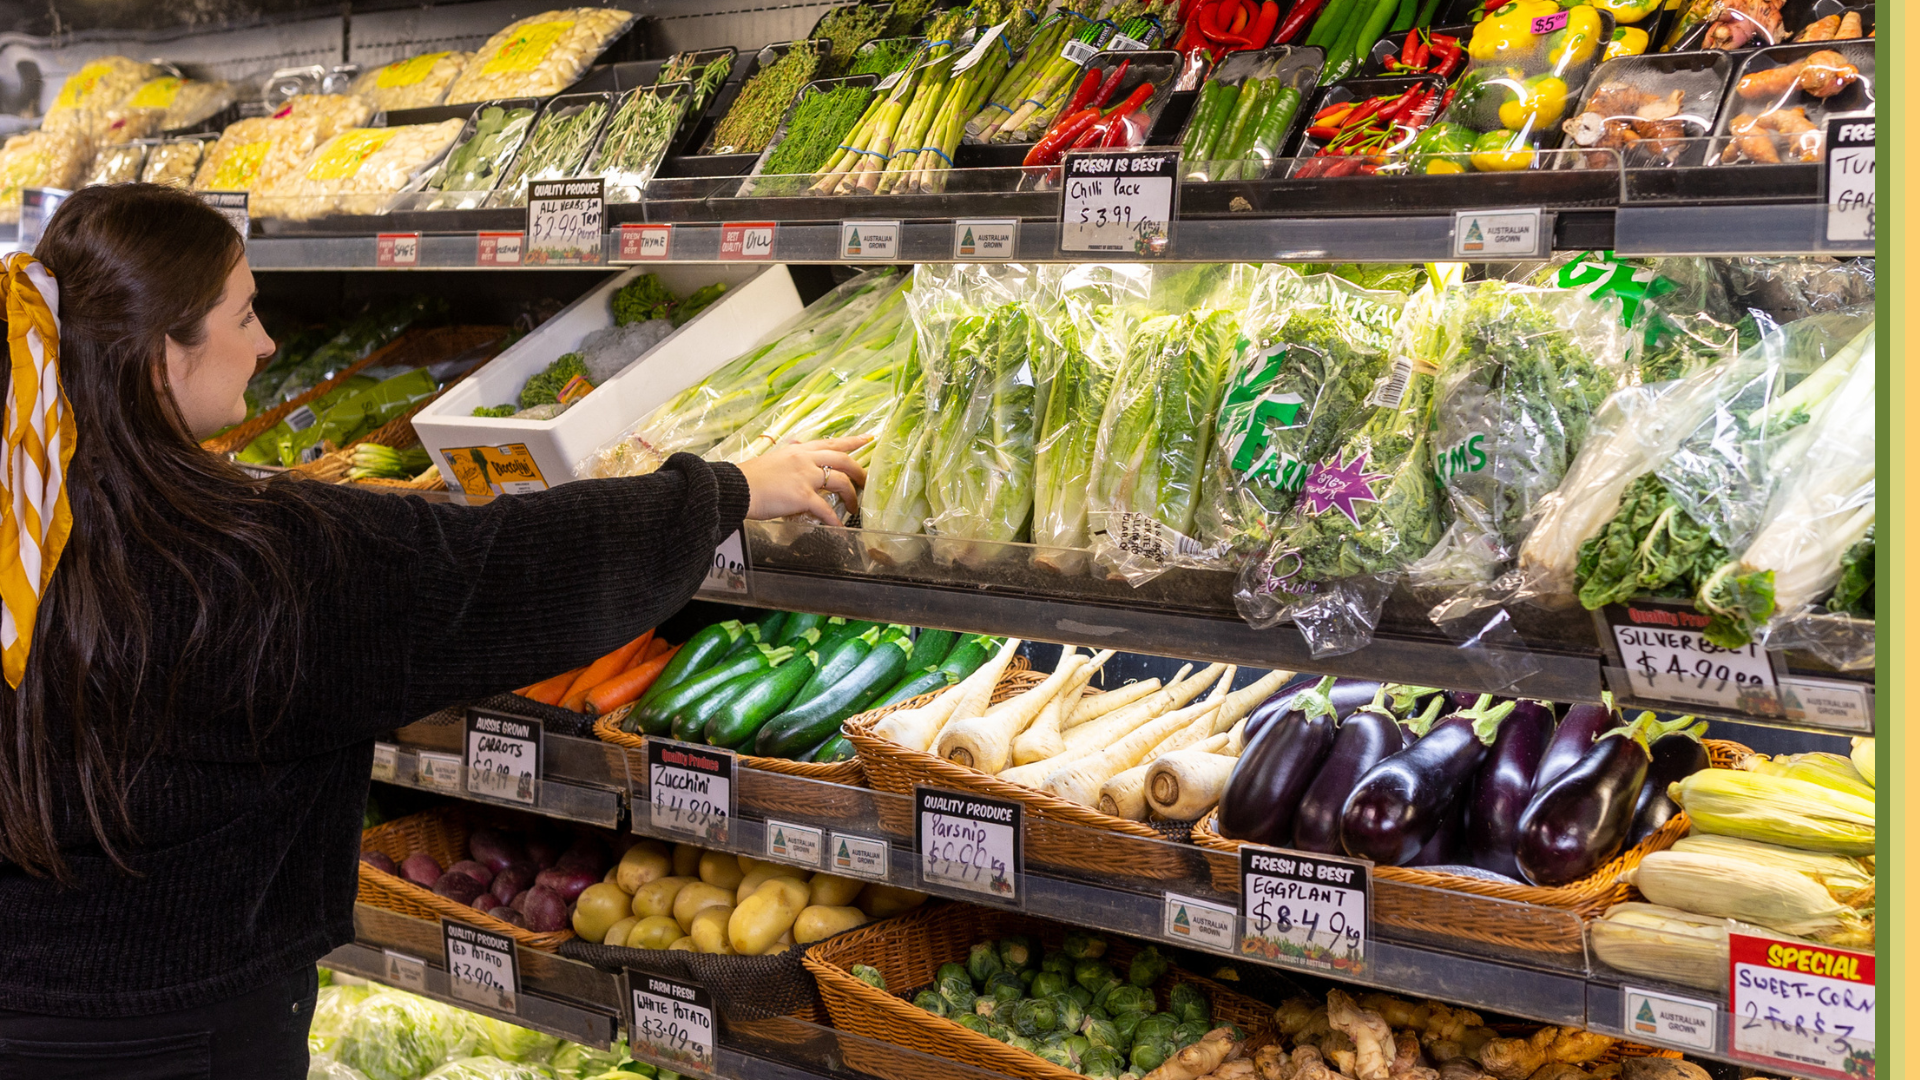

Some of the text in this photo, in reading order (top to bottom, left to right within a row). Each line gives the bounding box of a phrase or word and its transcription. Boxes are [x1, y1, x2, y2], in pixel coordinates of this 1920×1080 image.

[1072, 157, 1165, 173] FRESH IS BEST
[534, 182, 600, 197] QUALITY PRODUCE
[1071, 177, 1141, 199] Chilli Pack
[540, 201, 558, 214] ALL
[1080, 200, 1131, 232] $3.99
[533, 214, 578, 243] $2.99
[623, 232, 641, 240] FRESH
[727, 231, 739, 241] BEST
[978, 234, 1009, 242] AUSTRALIAN
[1487, 226, 1529, 234] AUSTRALIAN
[641, 236, 665, 248] THYME
[722, 241, 742, 253] QUALITY
[983, 241, 1003, 249] GROWN
[1495, 235, 1521, 243] GROWN
[624, 246, 637, 254] BEST
[1628, 608, 1679, 627] Quality
[476, 716, 530, 738] AUSSIE GROWN
[478, 736, 523, 758] CARROTS
[662, 748, 719, 772] Quality Produce
[655, 765, 710, 795] Zucchini
[924, 795, 1013, 822] QUALITY PRODUCE
[932, 813, 986, 849] Parsnip
[787, 837, 815, 848] AUSTRALIAN
[852, 849, 881, 859] AUSTRALIAN
[1251, 855, 1355, 884] FRESH IS BEST
[1254, 877, 1347, 906] EGGPLANT
[1192, 916, 1228, 931] AUSTRALIAN
[1200, 926, 1221, 937] GROWN
[447, 925, 509, 952] QUALITY PRODUCE
[471, 945, 502, 968] POTATO
[1767, 943, 1862, 981] SPECIAL
[649, 979, 696, 1001] FARM FRESH
[637, 994, 710, 1029] WHITE POTATO
[1660, 1011, 1706, 1028] AUSTRALIAN
[1742, 1001, 1762, 1030] 2
[642, 1015, 688, 1050] $3.99
[1668, 1022, 1697, 1035] GROWN
